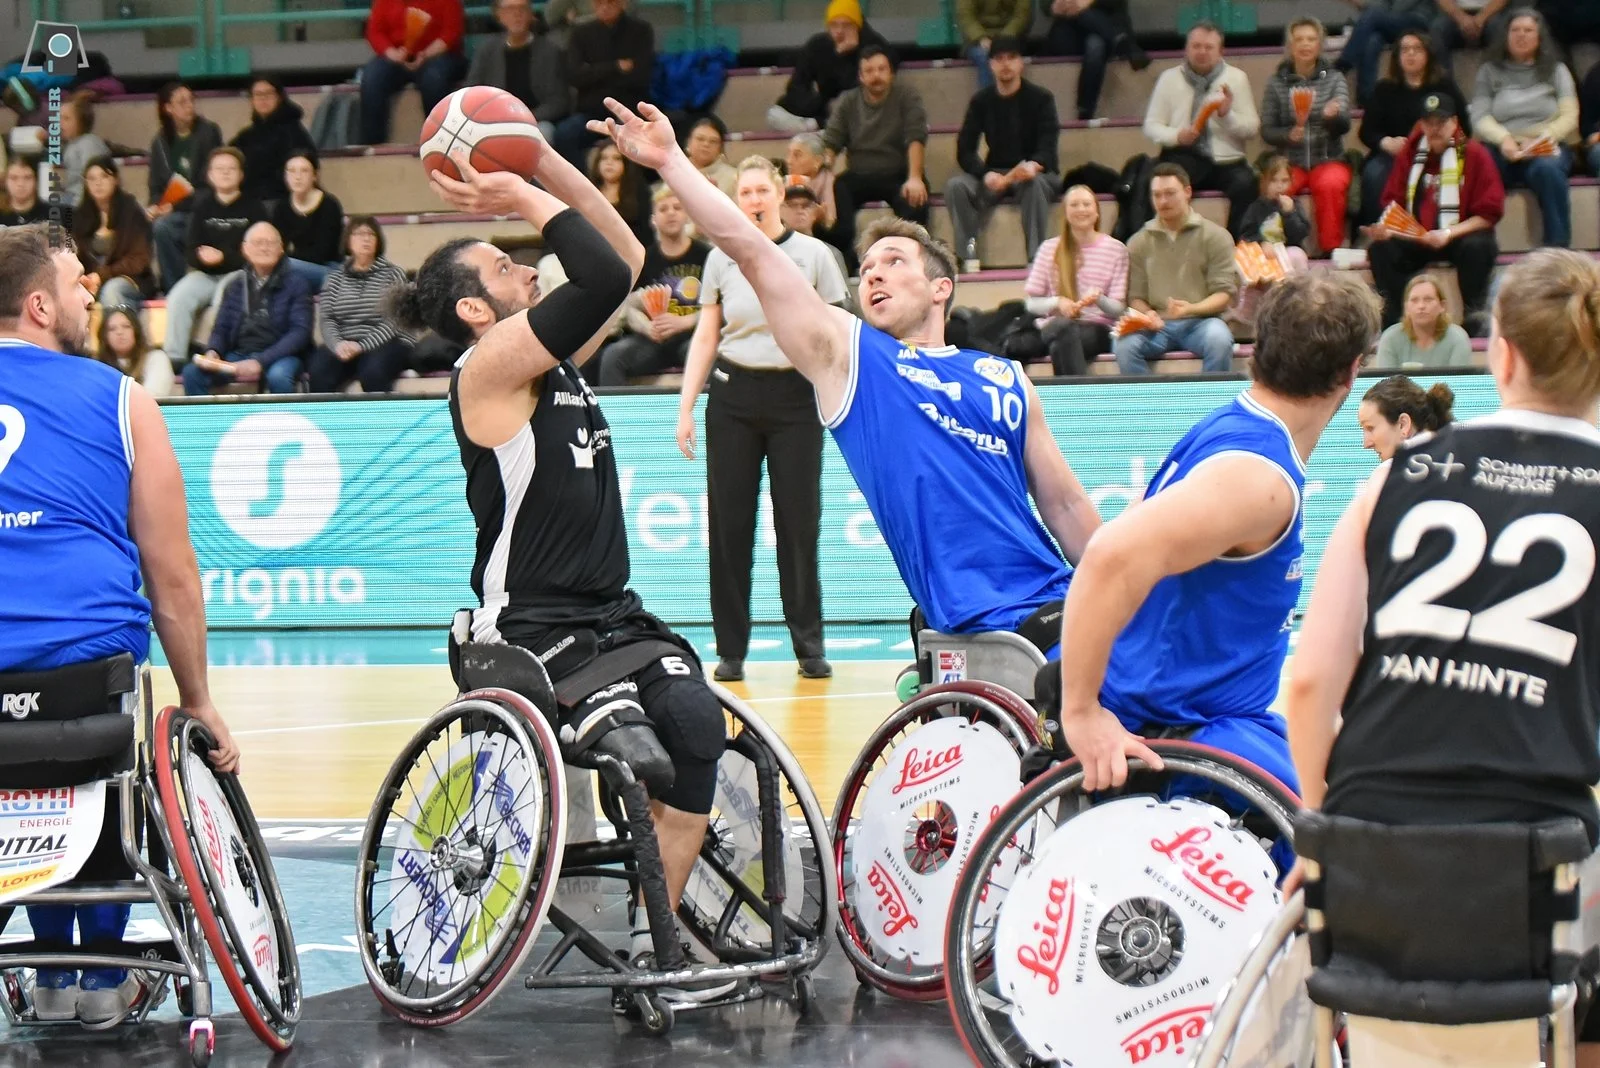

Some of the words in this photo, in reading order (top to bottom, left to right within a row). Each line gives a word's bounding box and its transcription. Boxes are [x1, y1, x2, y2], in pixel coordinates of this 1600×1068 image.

[982, 385, 1023, 431] 10
[1374, 500, 1596, 667] 22
[660, 656, 690, 675] 5
[1443, 659, 1548, 707] HINTE
[892, 743, 964, 794] Leica
[900, 776, 961, 810] MICROSYSTEMS
[20, 817, 73, 828] ENERGIE
[500, 799, 533, 859] BECHER
[1, 869, 52, 889] LOTTO
[1150, 826, 1255, 913] Leica
[867, 860, 918, 938] Leica
[1143, 865, 1226, 930] MICROSYSTEMS
[1017, 876, 1075, 995] Leica
[1115, 976, 1210, 1024] MICROSYSTEMS
[1120, 1004, 1214, 1064] eica
